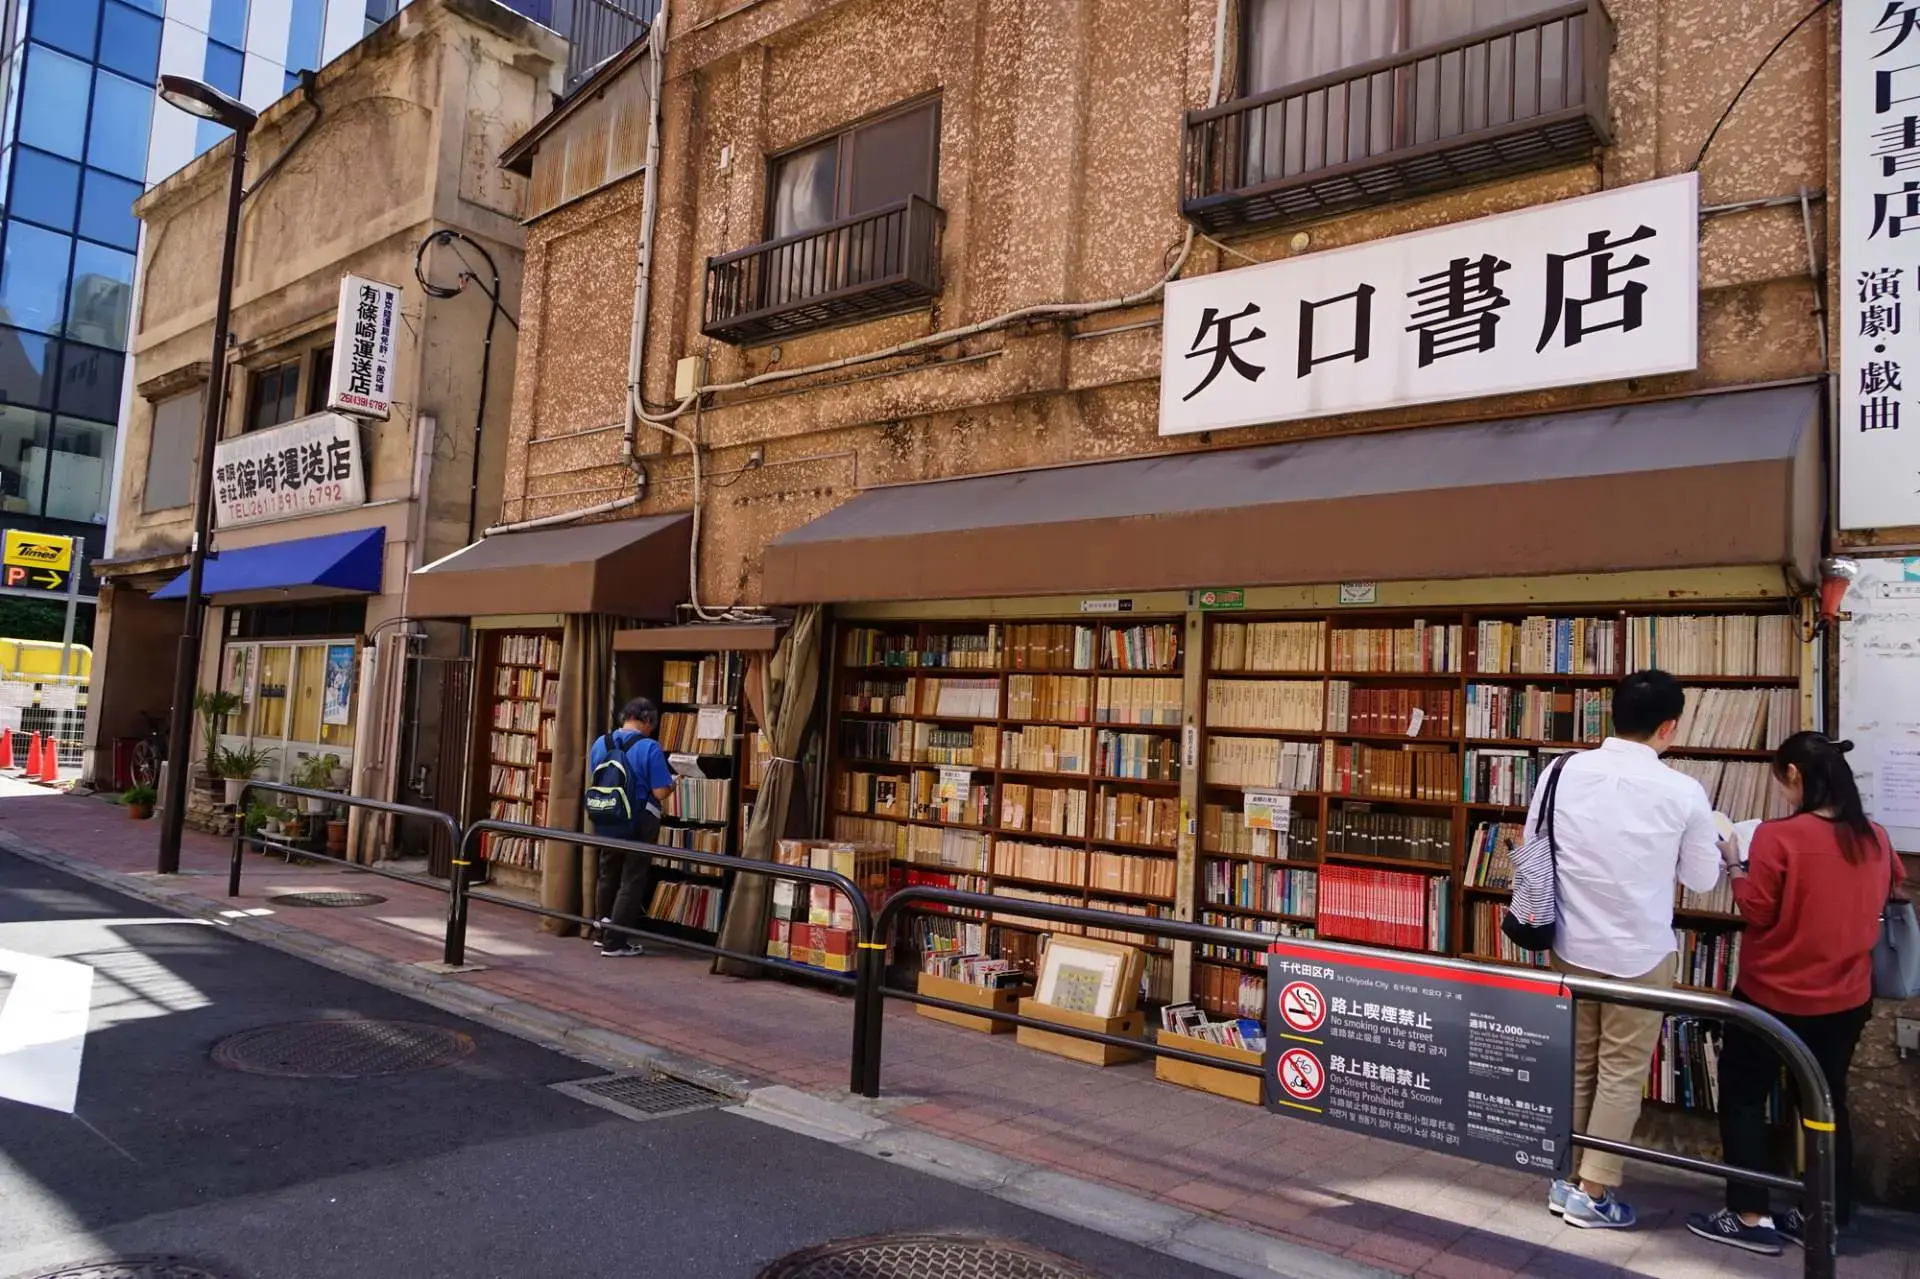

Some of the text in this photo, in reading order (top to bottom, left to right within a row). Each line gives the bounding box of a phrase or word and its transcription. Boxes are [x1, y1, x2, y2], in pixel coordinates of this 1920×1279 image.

[1182, 224, 1657, 402] 矢口書店
[1856, 267, 1904, 432] 演劇・戯曲
[17, 543, 63, 559] Times
[8, 567, 26, 586] P
[1280, 961, 1334, 980] 千代田区内
[1346, 976, 1373, 987] Chiyoda
[1375, 980, 1389, 990] City
[1331, 996, 1433, 1030] 路上喫煙禁止
[1330, 1015, 1433, 1042] No smoking on the street
[1489, 1022, 1523, 1036] ¥2,000
[1330, 1054, 1431, 1091] 路上駐輪禁止
[1330, 1073, 1443, 1105] On-Street Bicycle & Scooter
[1330, 1085, 1404, 1109] Parking Prohibited
